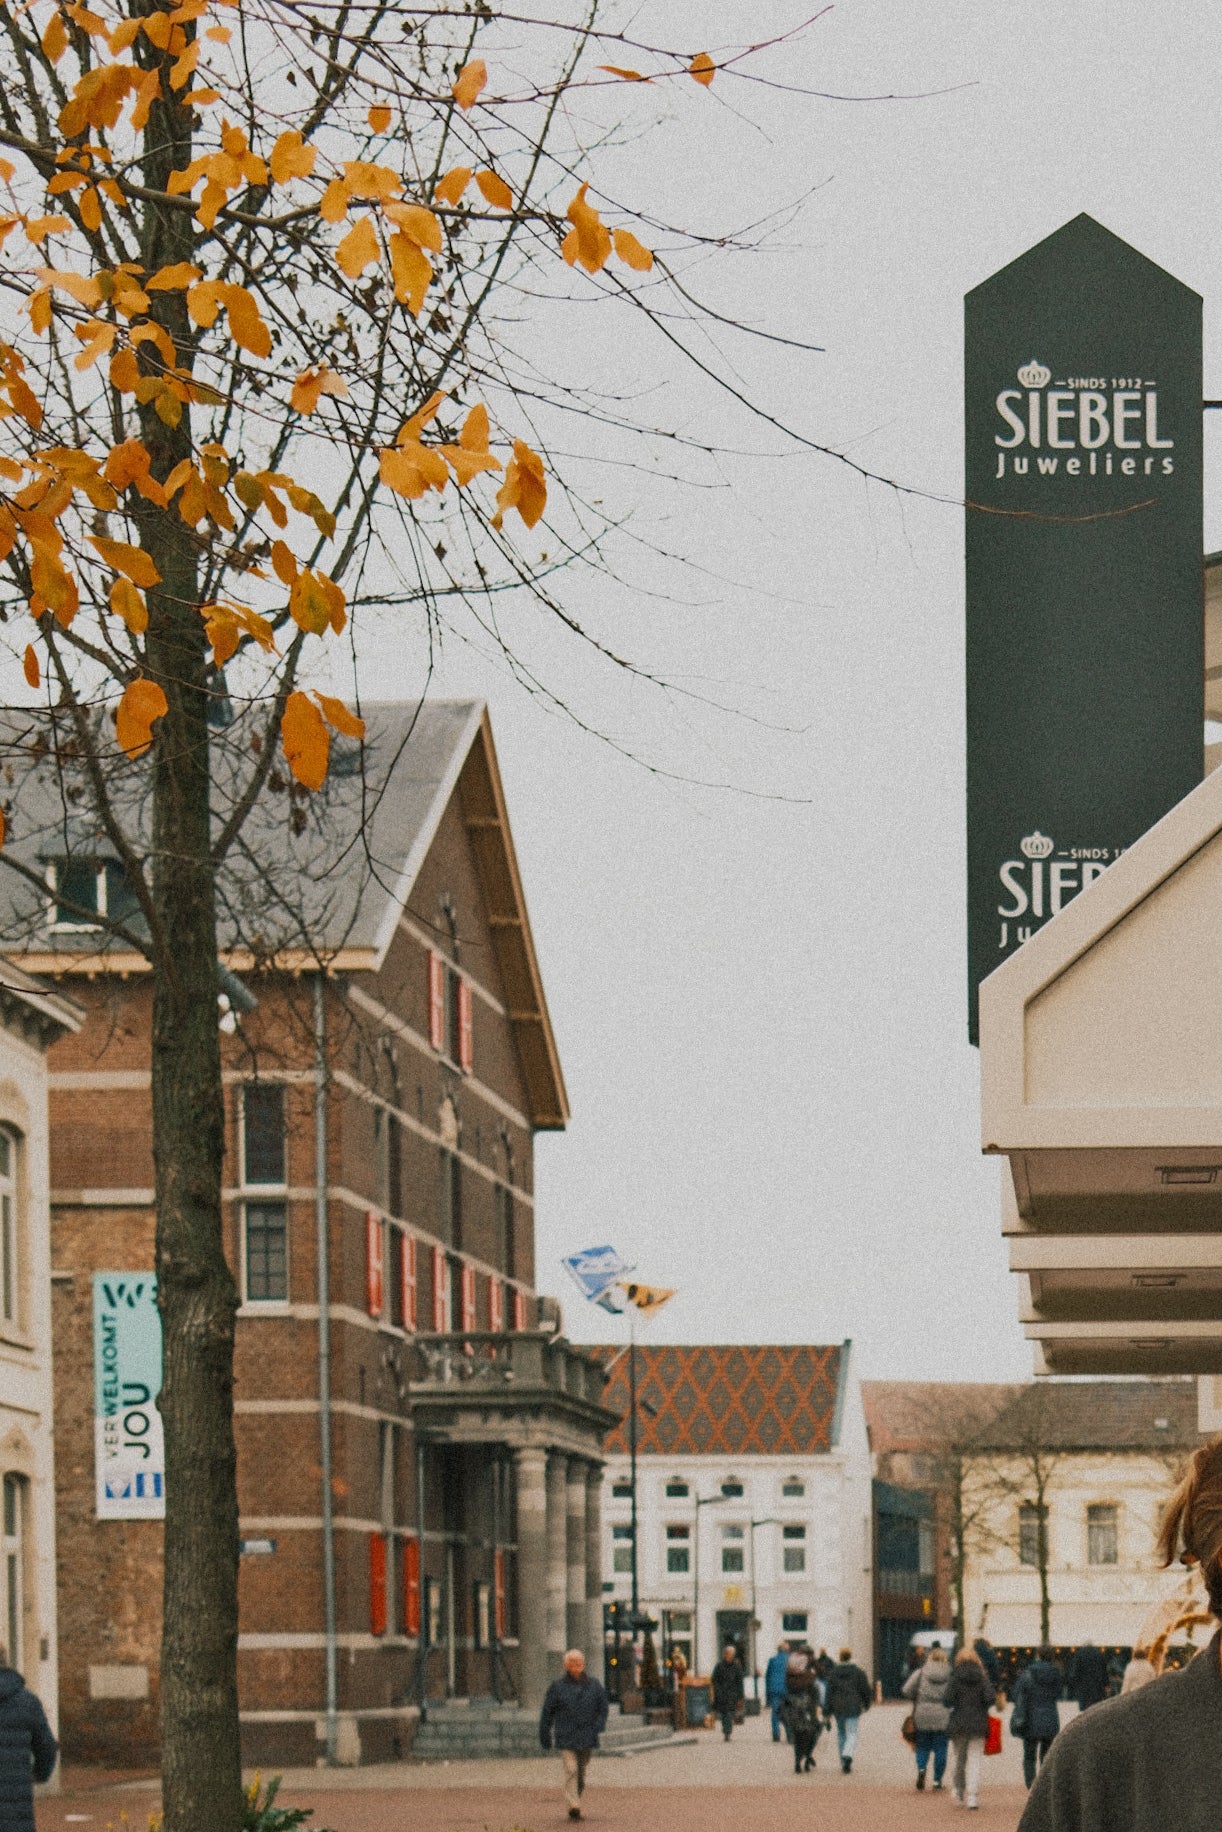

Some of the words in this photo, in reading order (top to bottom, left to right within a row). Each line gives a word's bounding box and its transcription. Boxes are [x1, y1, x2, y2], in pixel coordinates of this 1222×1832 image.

[1067, 378, 1107, 389] SINDS
[1111, 378, 1143, 389] 1912
[994, 389, 1175, 450] SIEBEL
[1070, 848, 1110, 860] SINDS
[101, 1313, 119, 1460] VERWELKOMT
[122, 1382, 151, 1460] JOU
